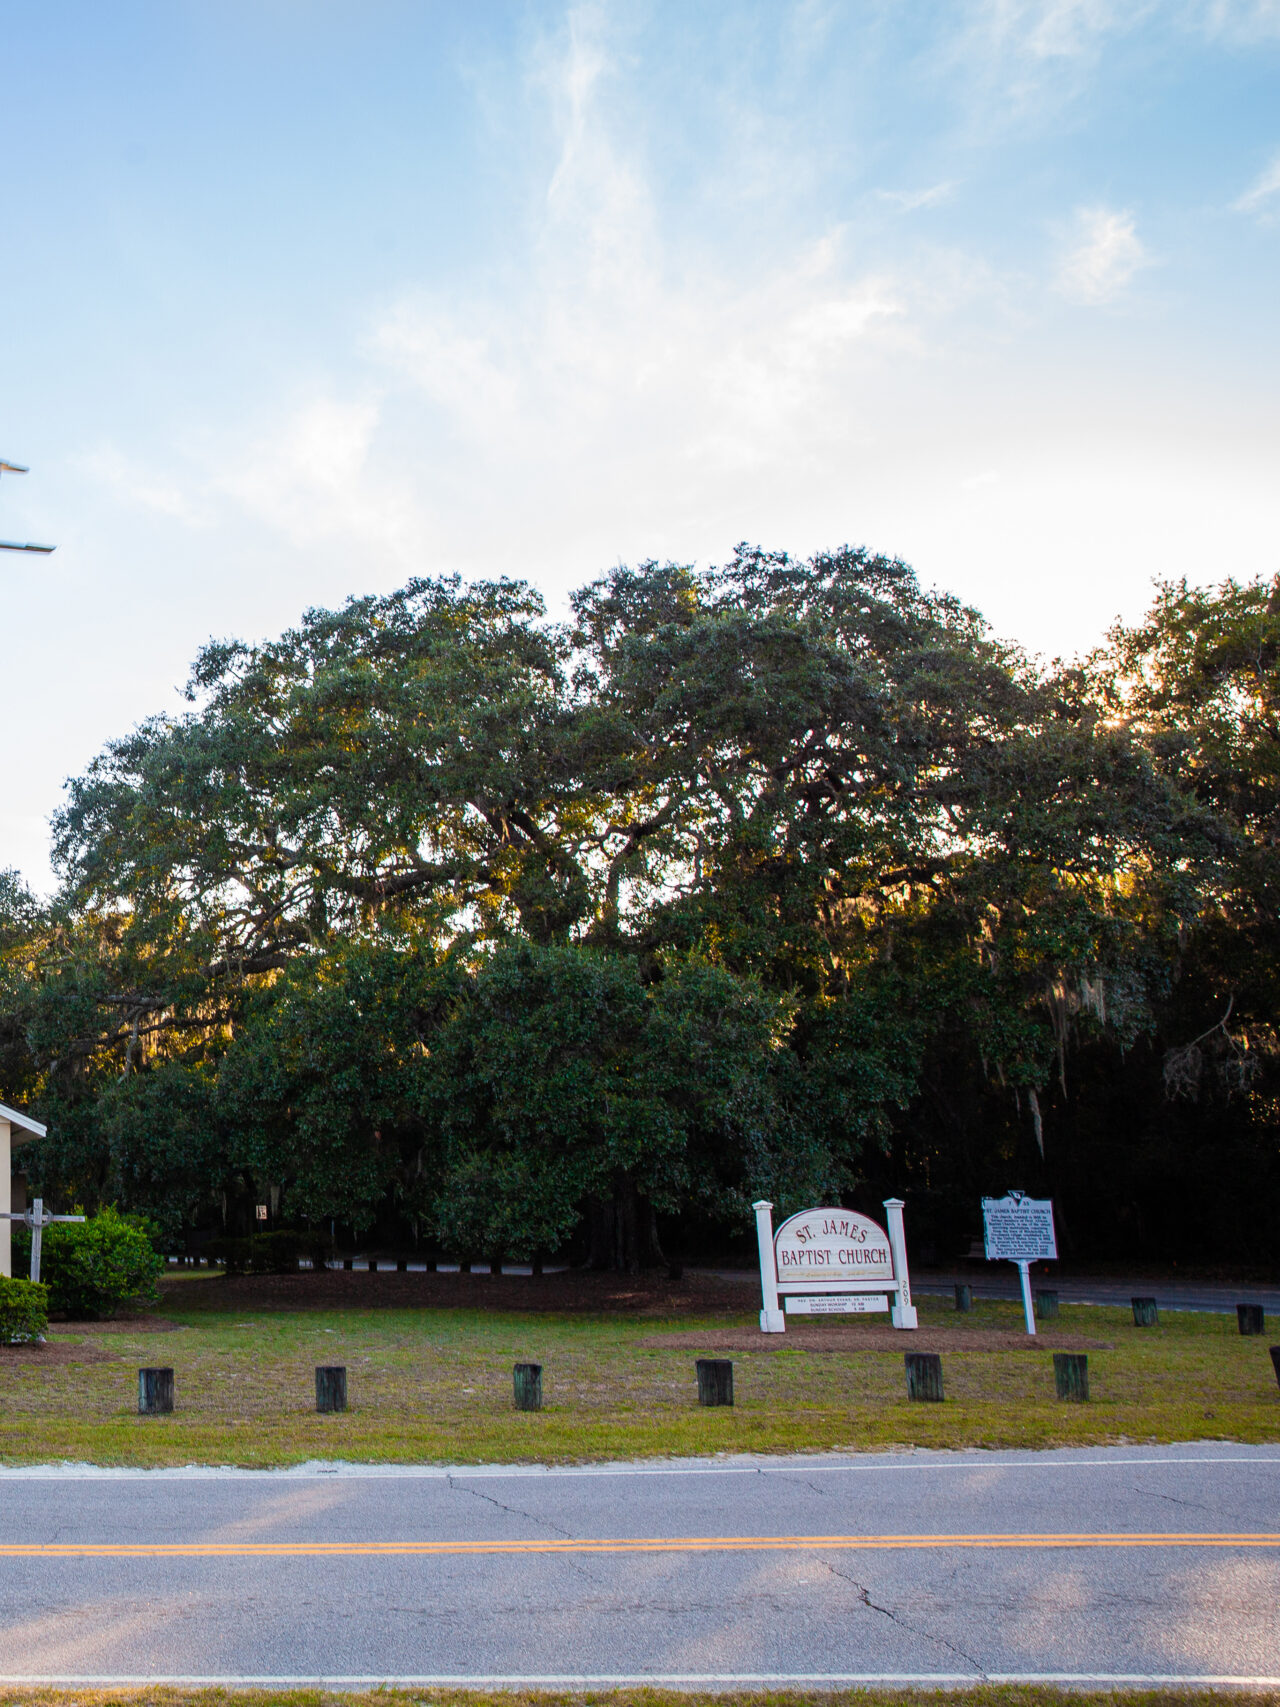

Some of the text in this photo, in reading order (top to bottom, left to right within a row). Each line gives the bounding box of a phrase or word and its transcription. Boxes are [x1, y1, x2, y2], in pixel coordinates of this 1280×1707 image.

[795, 1219, 868, 1244] ST. JAMES
[781, 1248, 887, 1265] BAPTIST CHURCH
